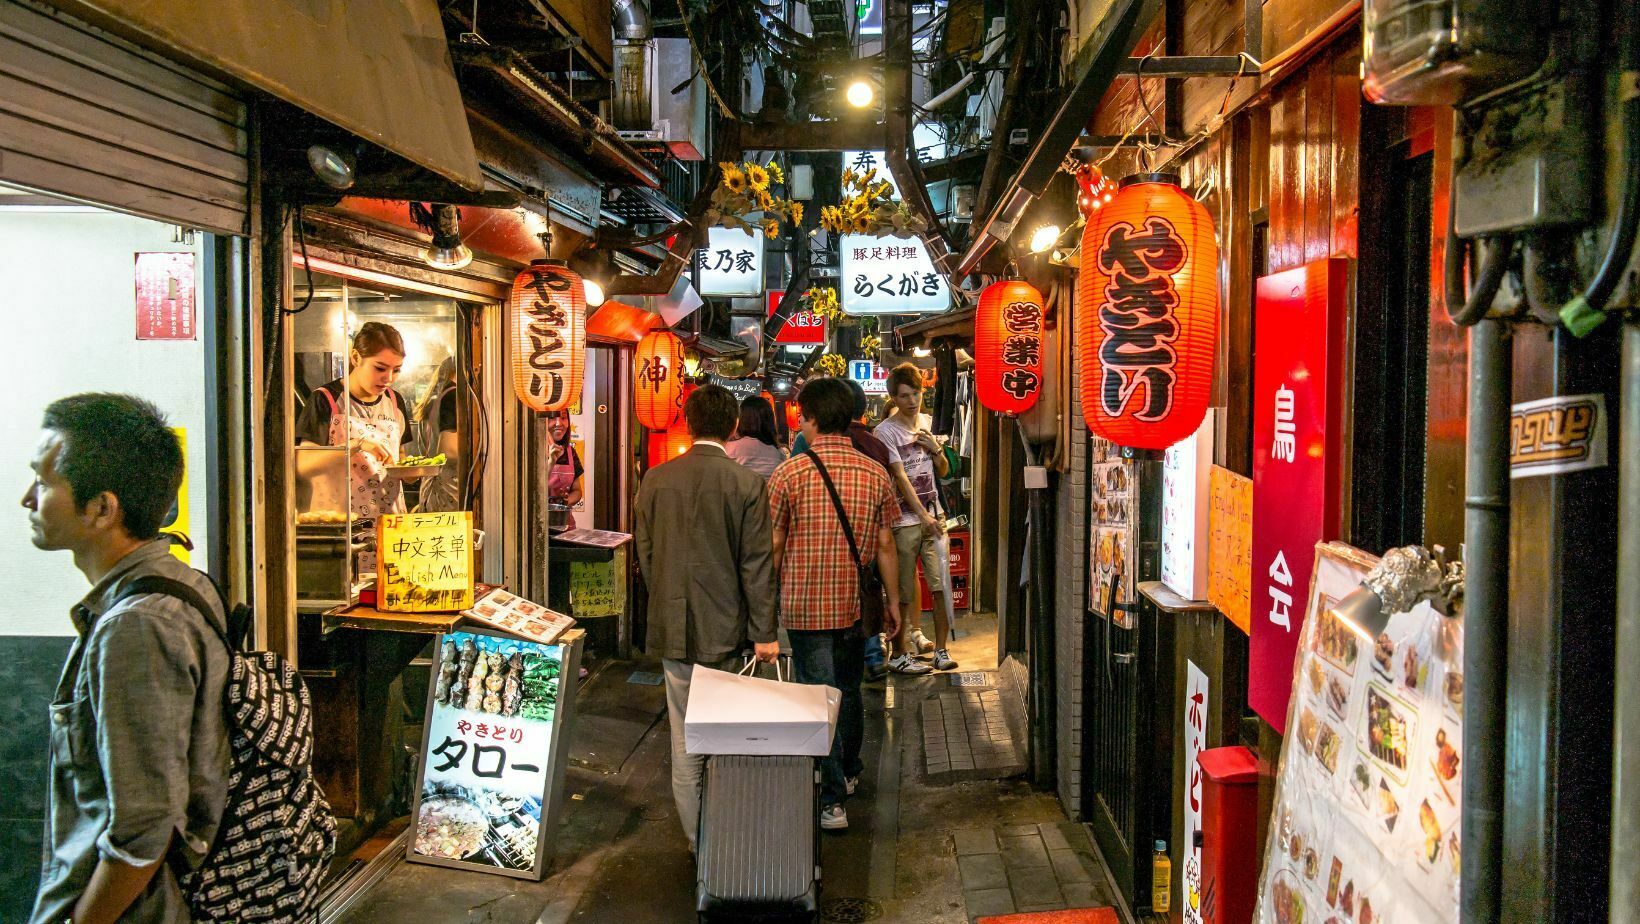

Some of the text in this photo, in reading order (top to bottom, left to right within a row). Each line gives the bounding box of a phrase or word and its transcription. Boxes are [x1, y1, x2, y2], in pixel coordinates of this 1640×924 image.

[853, 246, 918, 261] 豚足料理
[854, 270, 940, 298] らくがき
[1098, 216, 1189, 422] やきとり
[523, 271, 571, 406] やきとり
[1001, 301, 1042, 400] 営業中
[638, 355, 667, 394] 伸
[414, 514, 457, 528] テーブル
[393, 534, 465, 560] 中文菜单
[438, 564, 468, 580] Menu
[456, 719, 523, 744] やきとり
[431, 736, 540, 779] タロー
